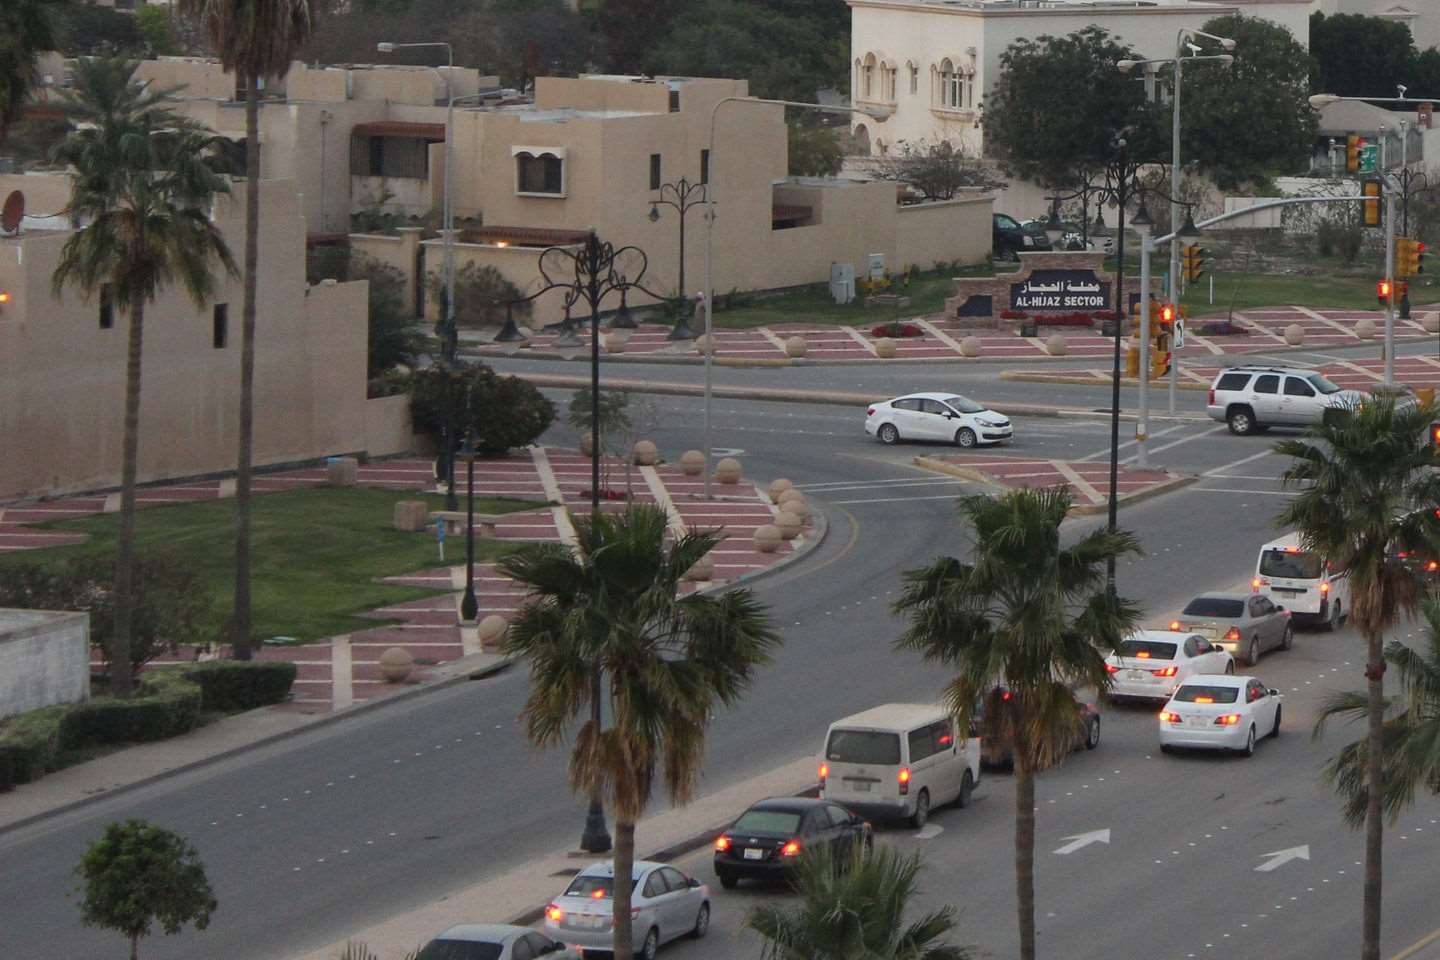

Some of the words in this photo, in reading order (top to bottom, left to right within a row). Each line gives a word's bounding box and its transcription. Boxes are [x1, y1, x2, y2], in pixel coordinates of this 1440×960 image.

[1021, 280, 1064, 295] الحجاز
[1067, 280, 1100, 292] محلة
[1016, 296, 1060, 307] AL-HIJAZ
[1064, 296, 1104, 307] SECTOR
